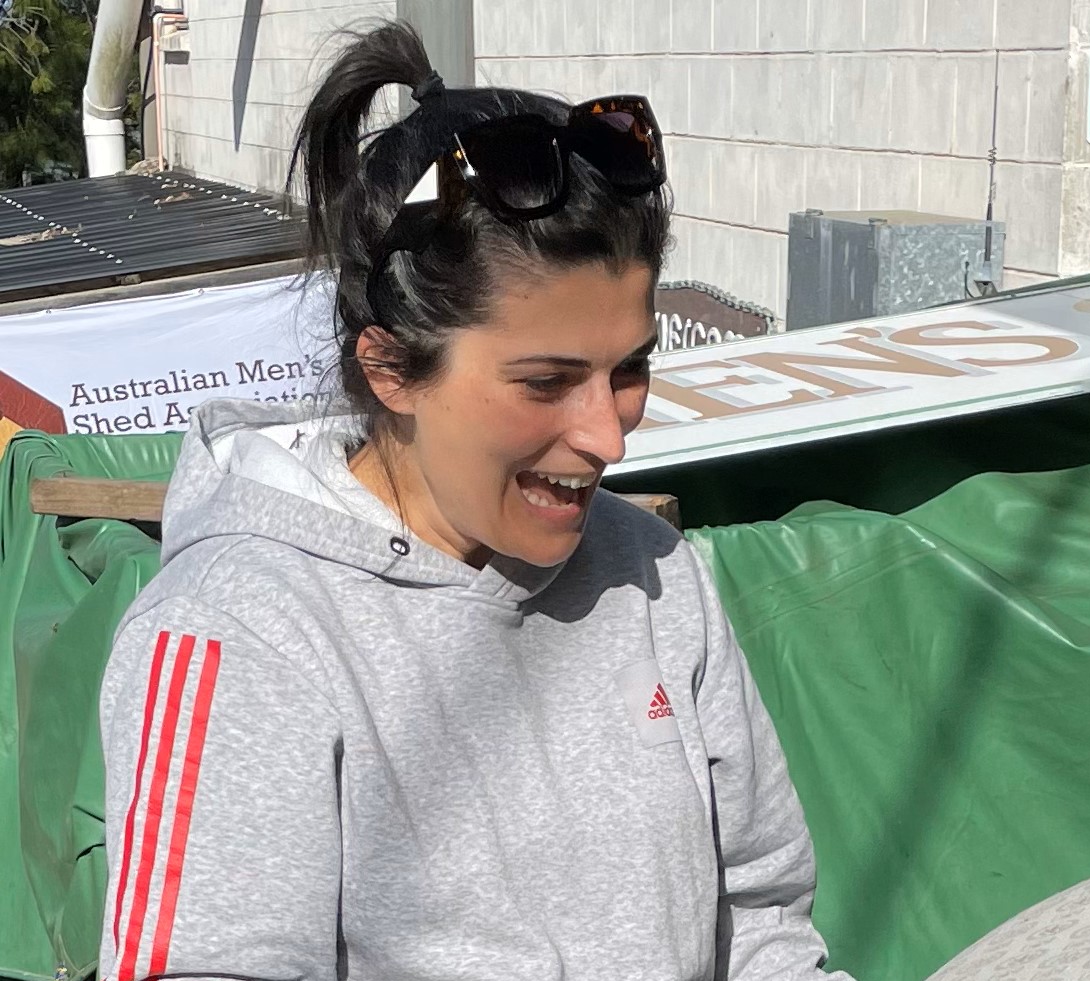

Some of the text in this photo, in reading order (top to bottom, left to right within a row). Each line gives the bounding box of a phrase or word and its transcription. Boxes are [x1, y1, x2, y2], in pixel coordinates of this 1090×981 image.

[69, 354, 324, 408] Australian Men's
[636, 320, 1079, 433] EN'S
[72, 406, 155, 435] Shed
